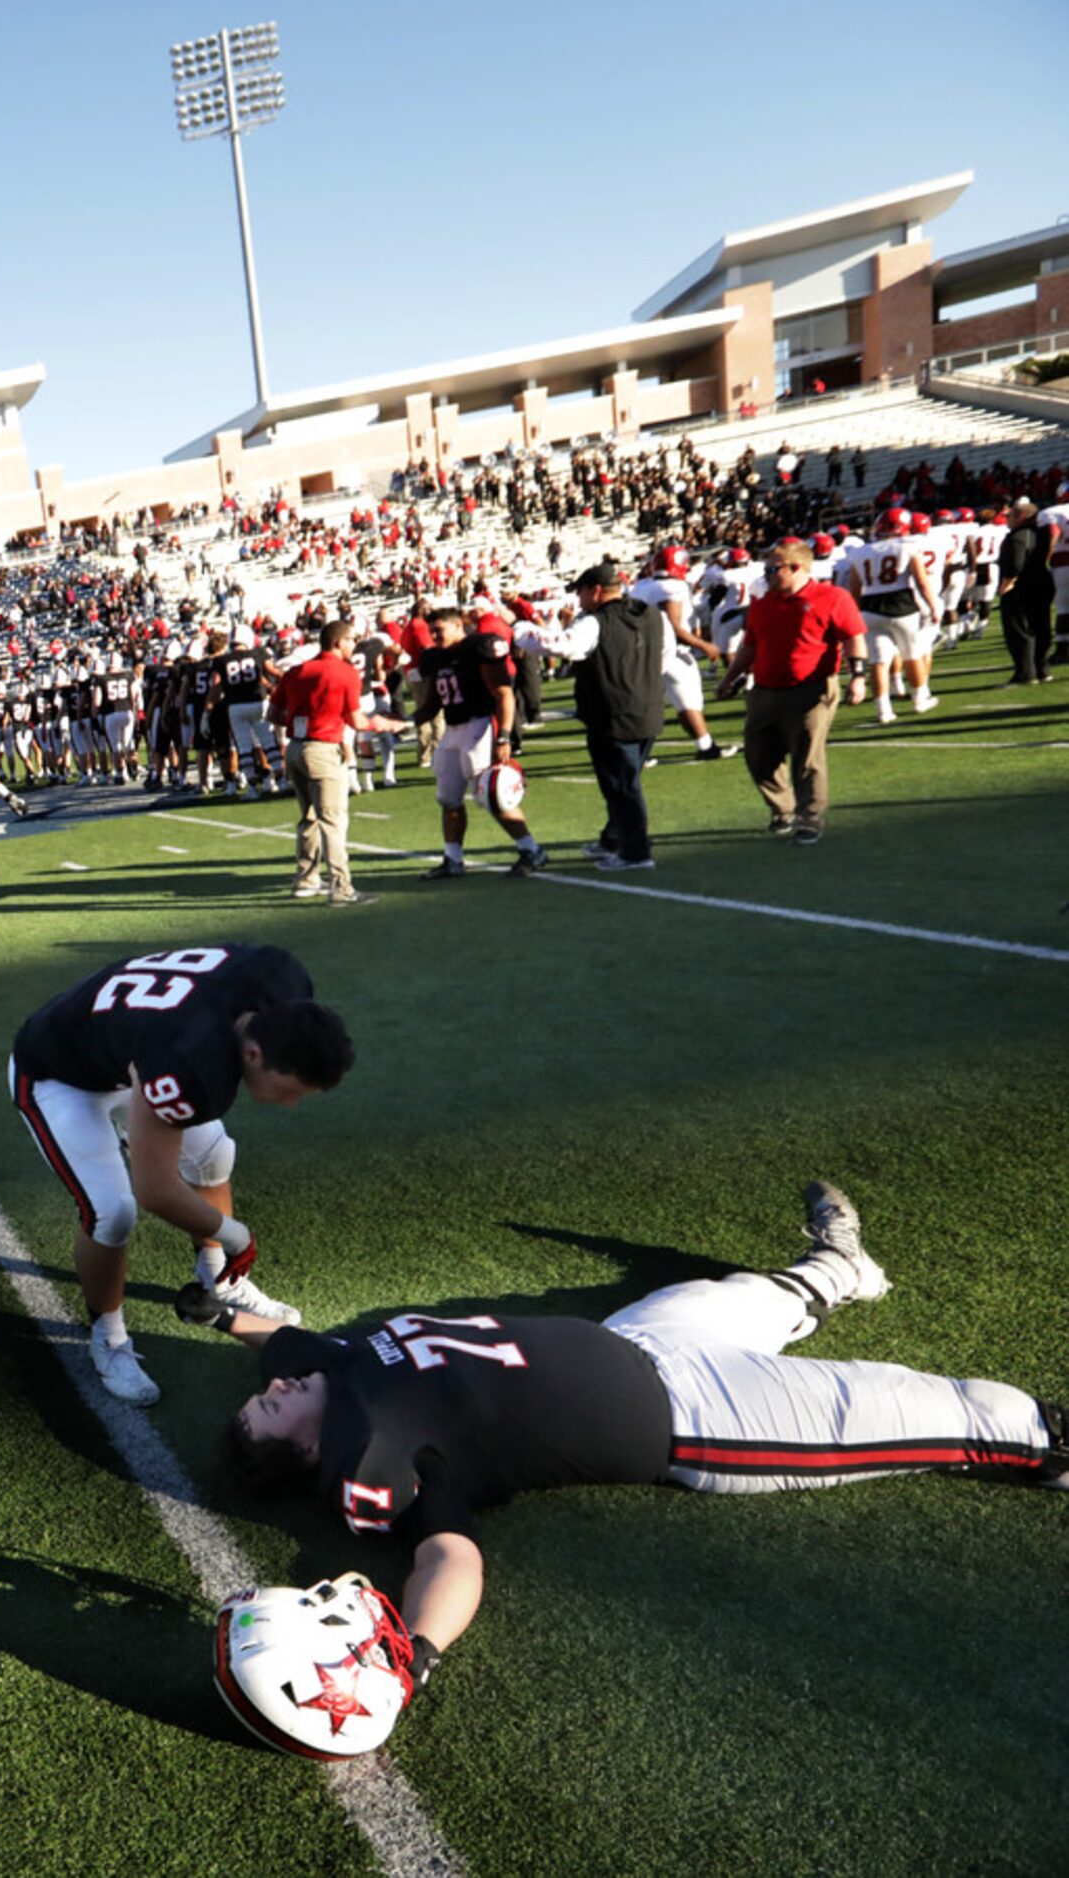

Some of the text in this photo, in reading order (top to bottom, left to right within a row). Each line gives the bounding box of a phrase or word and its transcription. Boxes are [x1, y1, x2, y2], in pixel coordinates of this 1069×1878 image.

[863, 555, 898, 586] 18
[226, 657, 258, 684] 89
[435, 675, 464, 705] 91
[144, 1074, 195, 1127] 92
[384, 1313, 528, 1371] 77
